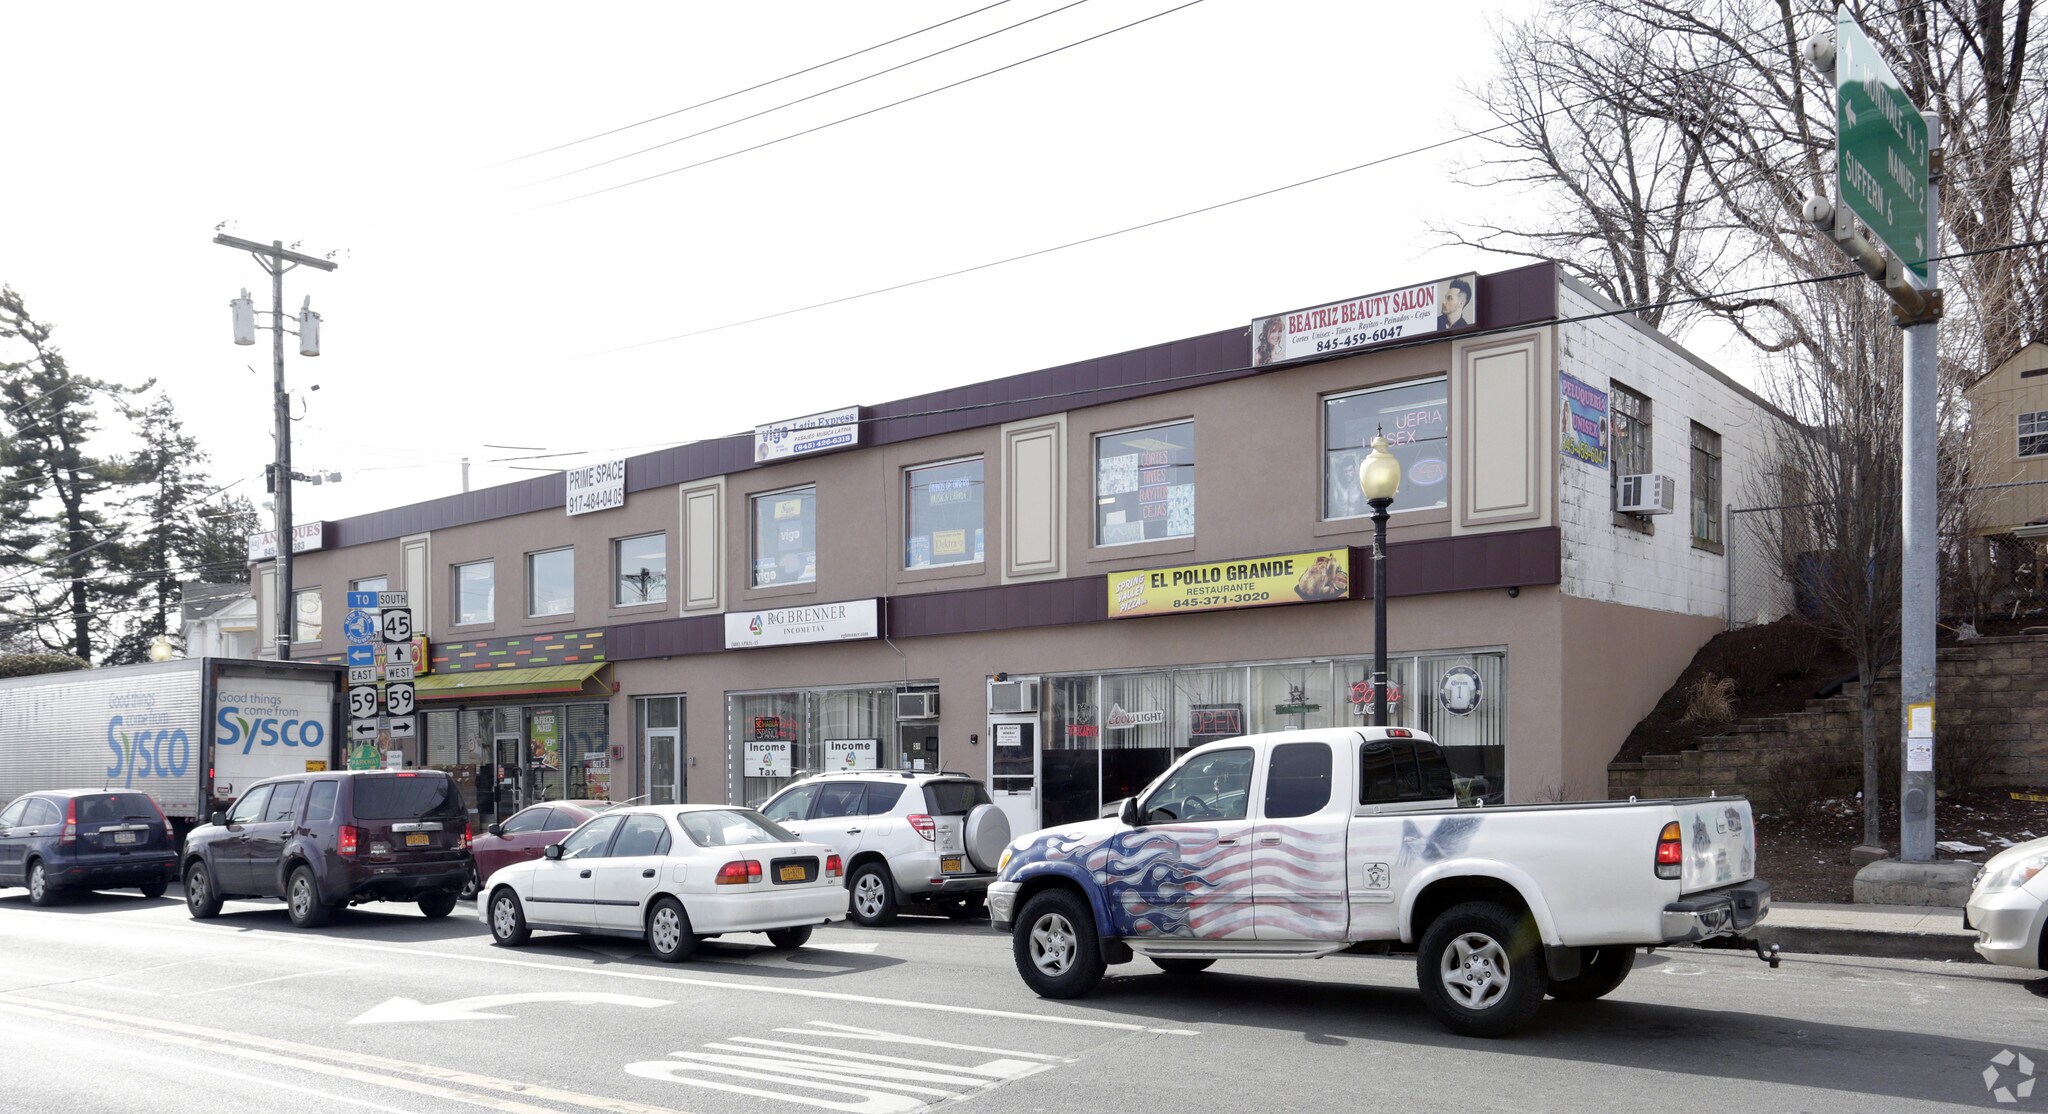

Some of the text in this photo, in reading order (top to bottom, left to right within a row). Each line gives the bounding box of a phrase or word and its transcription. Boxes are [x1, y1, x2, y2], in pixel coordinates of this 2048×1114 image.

[1863, 63, 1924, 167] MONTVALE NJ 3
[1846, 149, 1893, 227] SUFFERN 6
[1888, 146, 1924, 215] NANUET 2
[1288, 286, 1435, 334] BEATRIZ BEAUTY SALON
[1292, 309, 1430, 344] Cortes Unisex Tintes Rayitos Peinados Cejas
[1316, 326, 1403, 352] 845-459-6047
[793, 413, 855, 432] Latin Express
[1572, 412, 1599, 438] UNISEX
[762, 425, 788, 444] vigo
[794, 442, 815, 452] (845)
[816, 435, 851, 447] 426-6318
[1141, 450, 1169, 466] CORTES
[569, 460, 623, 491] PRIME SPACE
[1143, 468, 1167, 484] TINTES
[1143, 503, 1167, 518] CEJAS
[262, 524, 321, 545] ANQUES
[780, 529, 800, 542] vigo
[755, 569, 776, 583] vigo
[1151, 560, 1294, 588] EL POLLO GRANDE
[1116, 574, 1145, 593] SPRING
[1186, 582, 1255, 596] RESTAURANTE
[356, 595, 369, 605] TO
[380, 594, 406, 604] SOUTH
[1118, 584, 1145, 602] VALLEY
[1173, 592, 1270, 608] 845-371-3020
[1119, 598, 1142, 613] PIZZA
[344, 612, 372, 625] NEW YORK
[767, 605, 846, 625] R&G BRENNER
[386, 616, 409, 635] 45
[783, 625, 825, 635] INCOME TAX
[840, 631, 869, 639] rgbrenner.com
[351, 669, 372, 680] EAST
[388, 667, 410, 678] WEST
[219, 691, 282, 707] Good things
[351, 692, 374, 713] 59
[389, 690, 411, 709] 59
[244, 705, 299, 717] come from
[1353, 702, 1399, 715] LIGT
[1109, 711, 1163, 725] Coors LIGHT
[1190, 711, 1239, 734] OPEN
[749, 743, 786, 752] Income
[831, 741, 871, 751] Income
[759, 767, 777, 776] Tax
